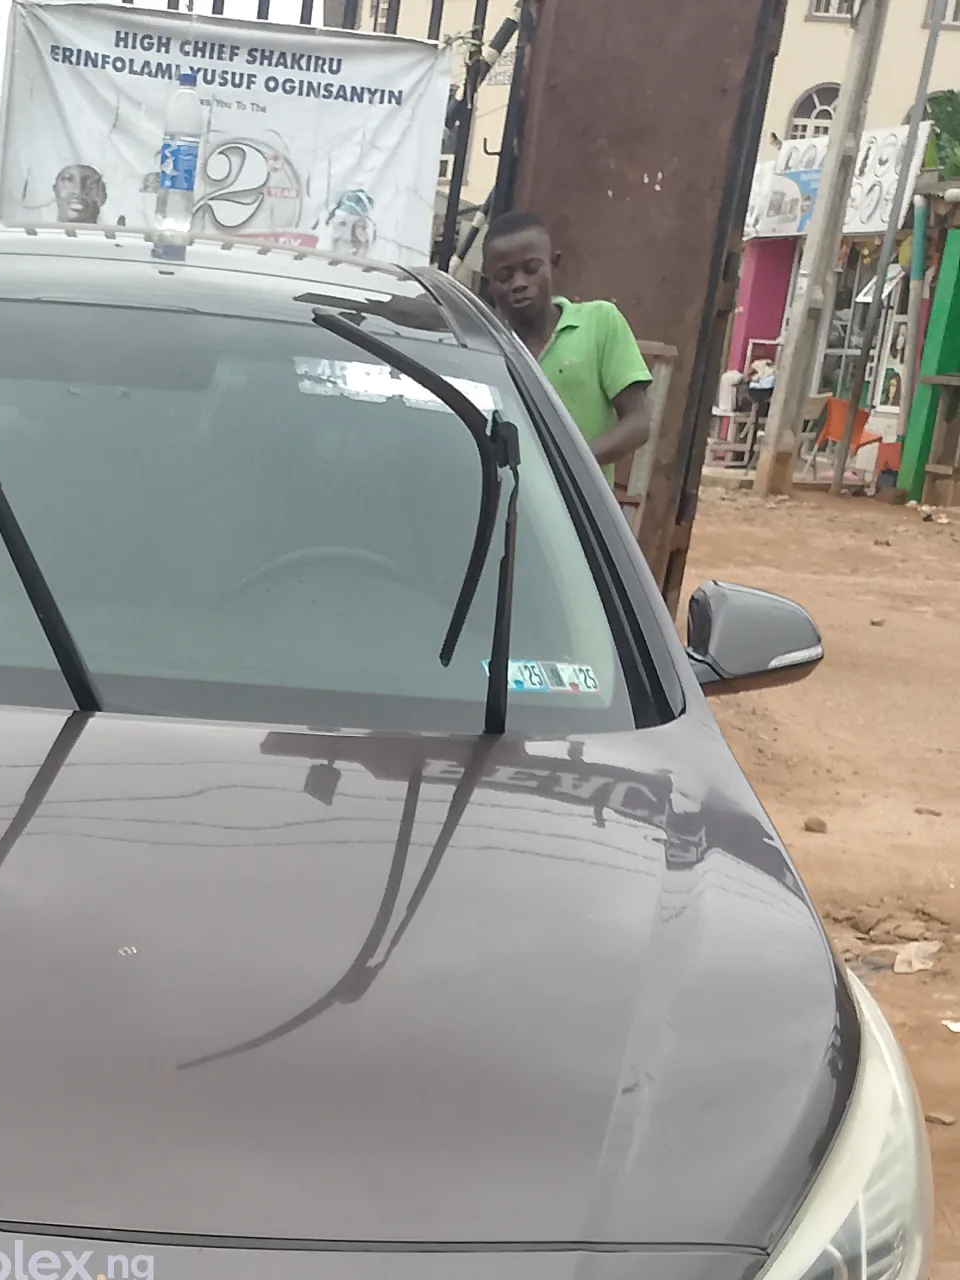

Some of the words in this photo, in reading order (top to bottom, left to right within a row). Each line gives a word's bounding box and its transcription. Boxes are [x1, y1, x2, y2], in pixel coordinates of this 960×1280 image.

[114, 30, 171, 54] HIGH
[179, 39, 239, 62] CHIEF
[246, 47, 342, 75] SHAKIRU
[50, 45, 180, 81] ERINFOLAMI
[188, 66, 257, 90] YUSUF
[264, 75, 403, 106] OGINSANYIN
[236, 101, 247, 110] To
